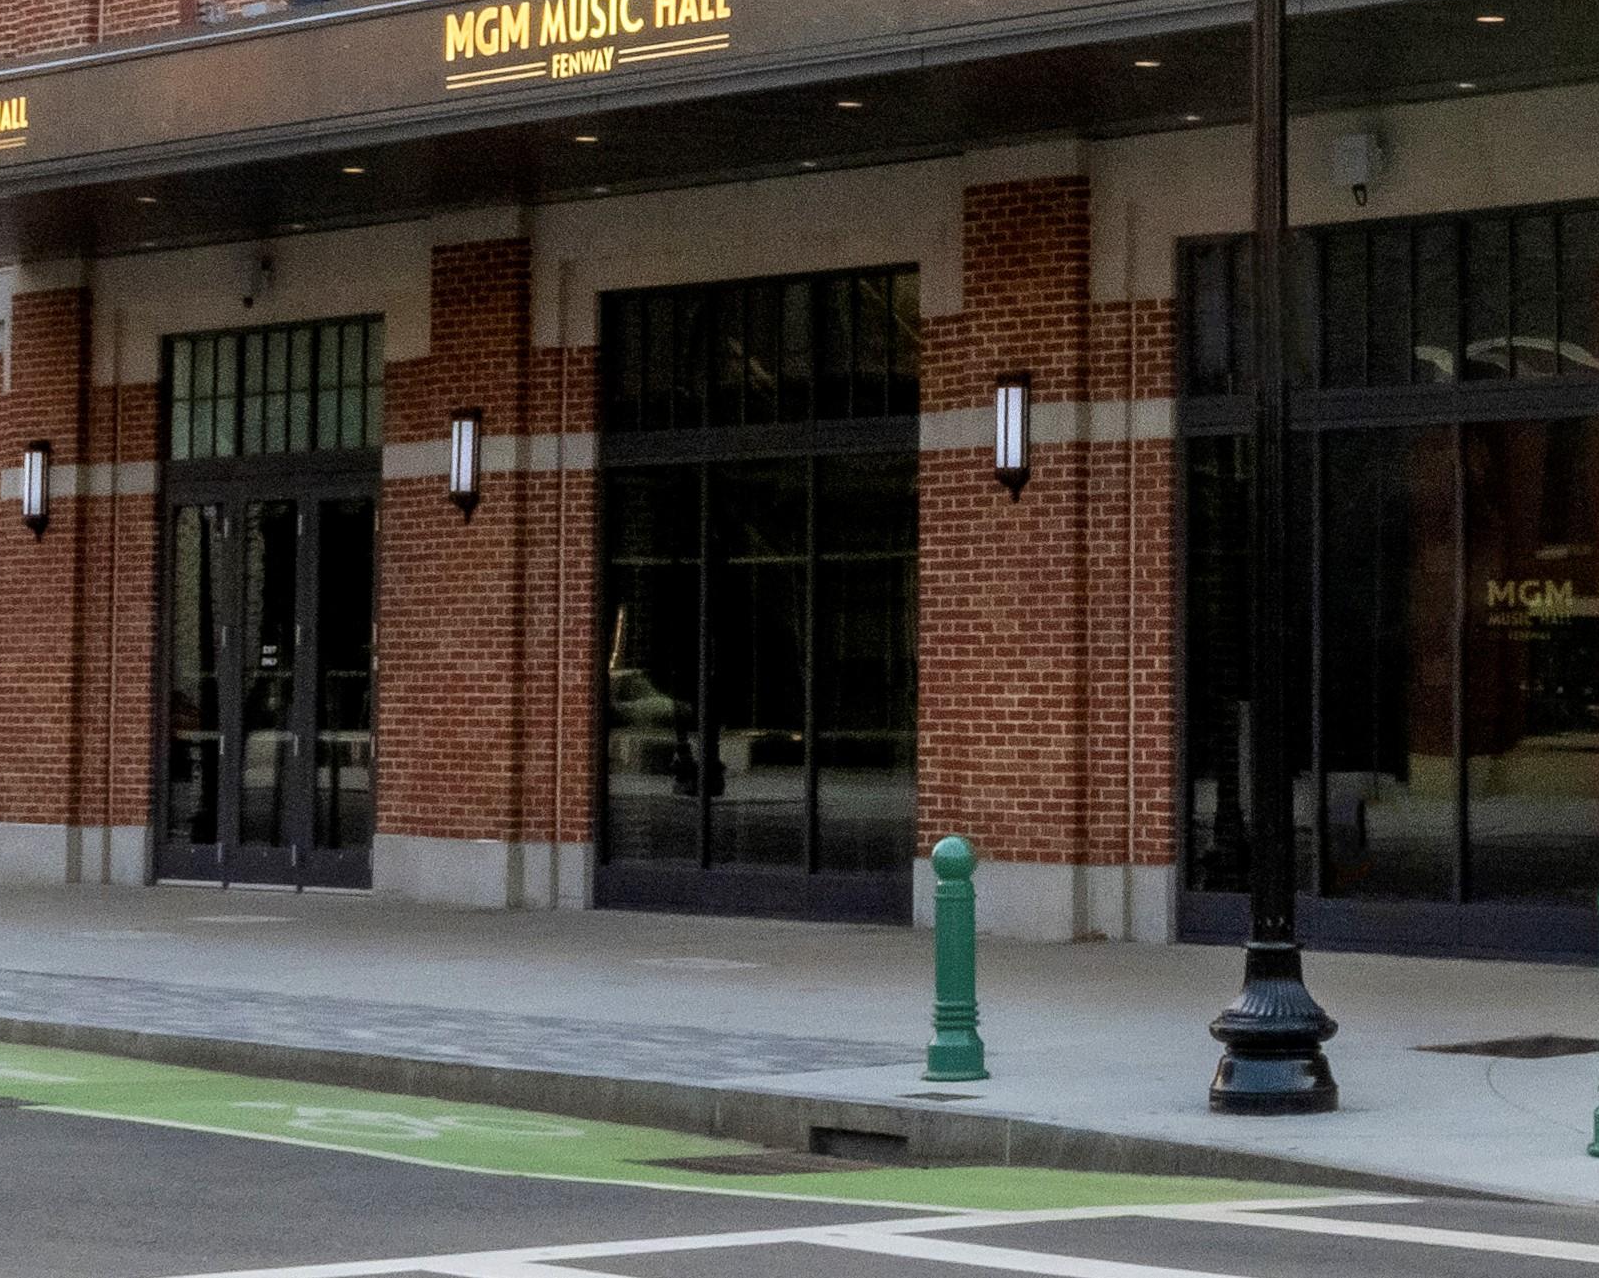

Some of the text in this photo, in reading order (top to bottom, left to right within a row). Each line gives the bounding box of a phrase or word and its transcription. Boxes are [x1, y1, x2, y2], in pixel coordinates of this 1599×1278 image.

[445, 1, 531, 62] MGM
[551, 46, 615, 79] FENWAY
[1487, 579, 1573, 607] MGM
